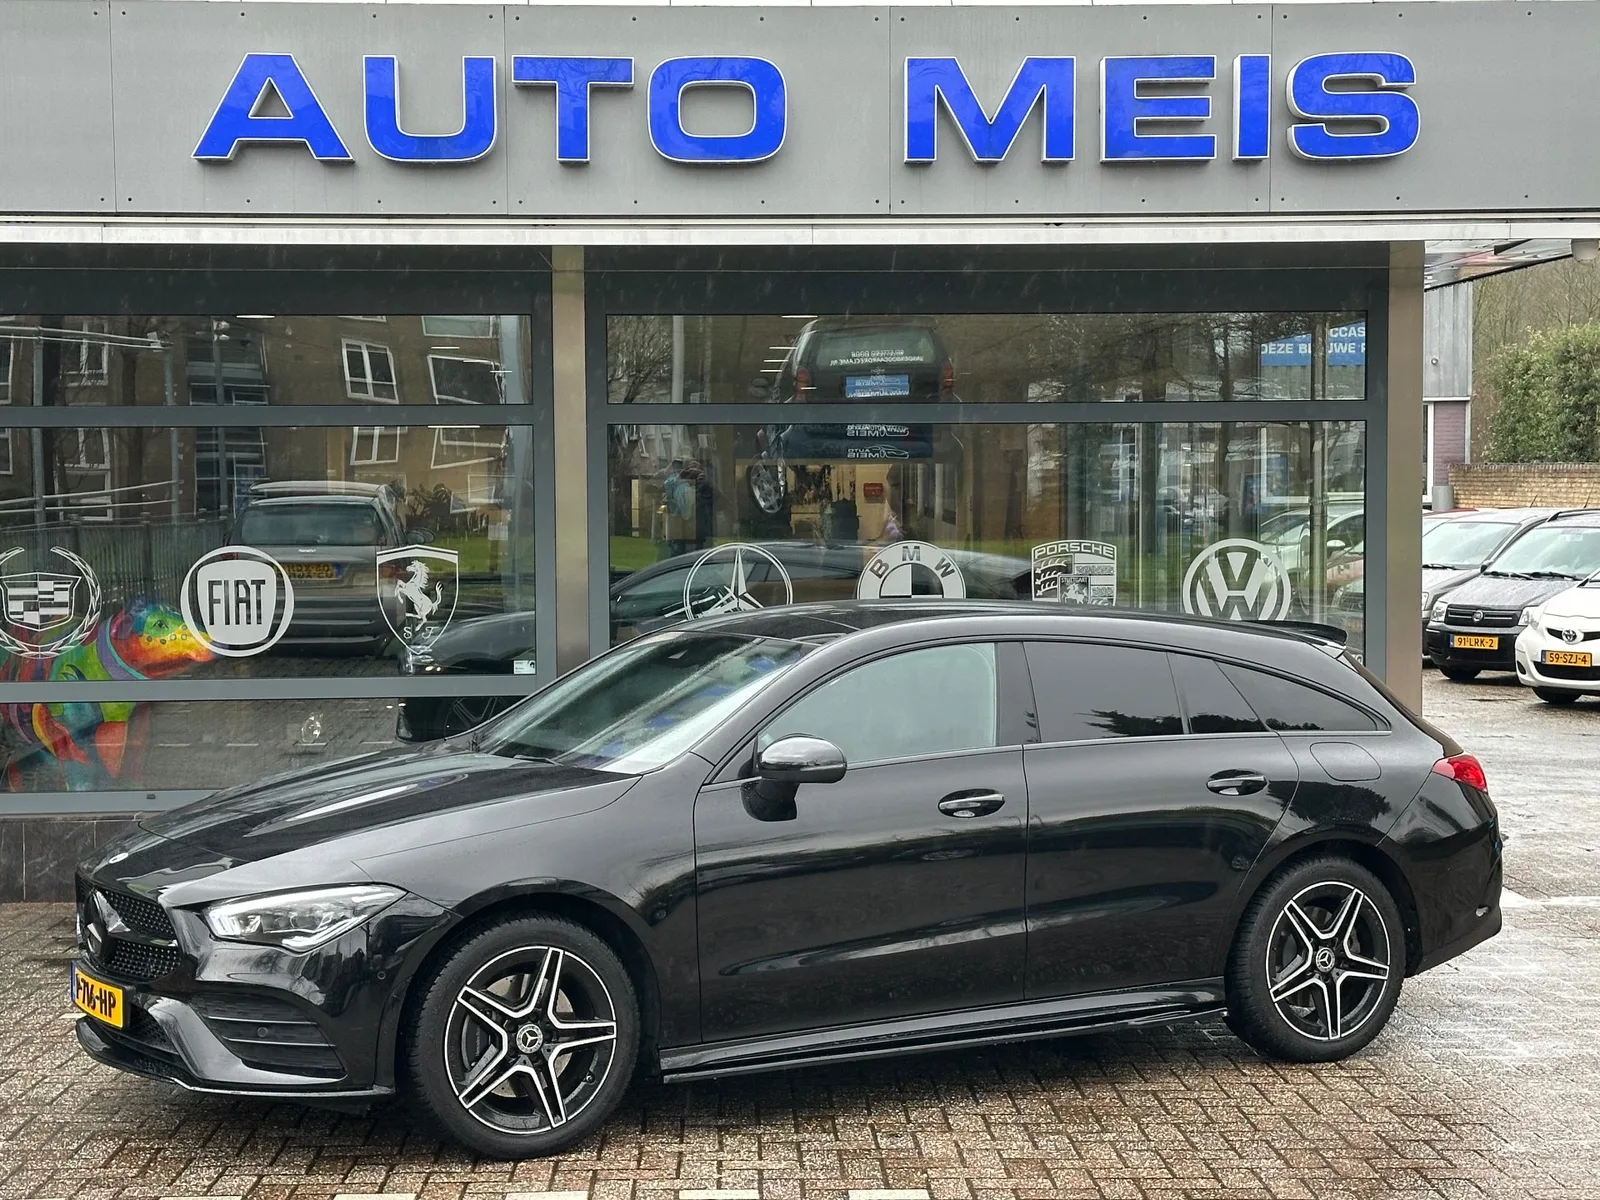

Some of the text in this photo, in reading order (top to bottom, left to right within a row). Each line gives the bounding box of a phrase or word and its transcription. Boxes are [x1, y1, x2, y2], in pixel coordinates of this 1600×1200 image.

[191, 51, 1421, 164] AUTO MEIS
[869, 546, 955, 579] BMW
[1035, 543, 1114, 560] PORSCHE
[208, 580, 266, 625] FIAT
[1457, 636, 1494, 649] 91-LRK-2
[1549, 652, 1588, 666] 59-SZJ-4
